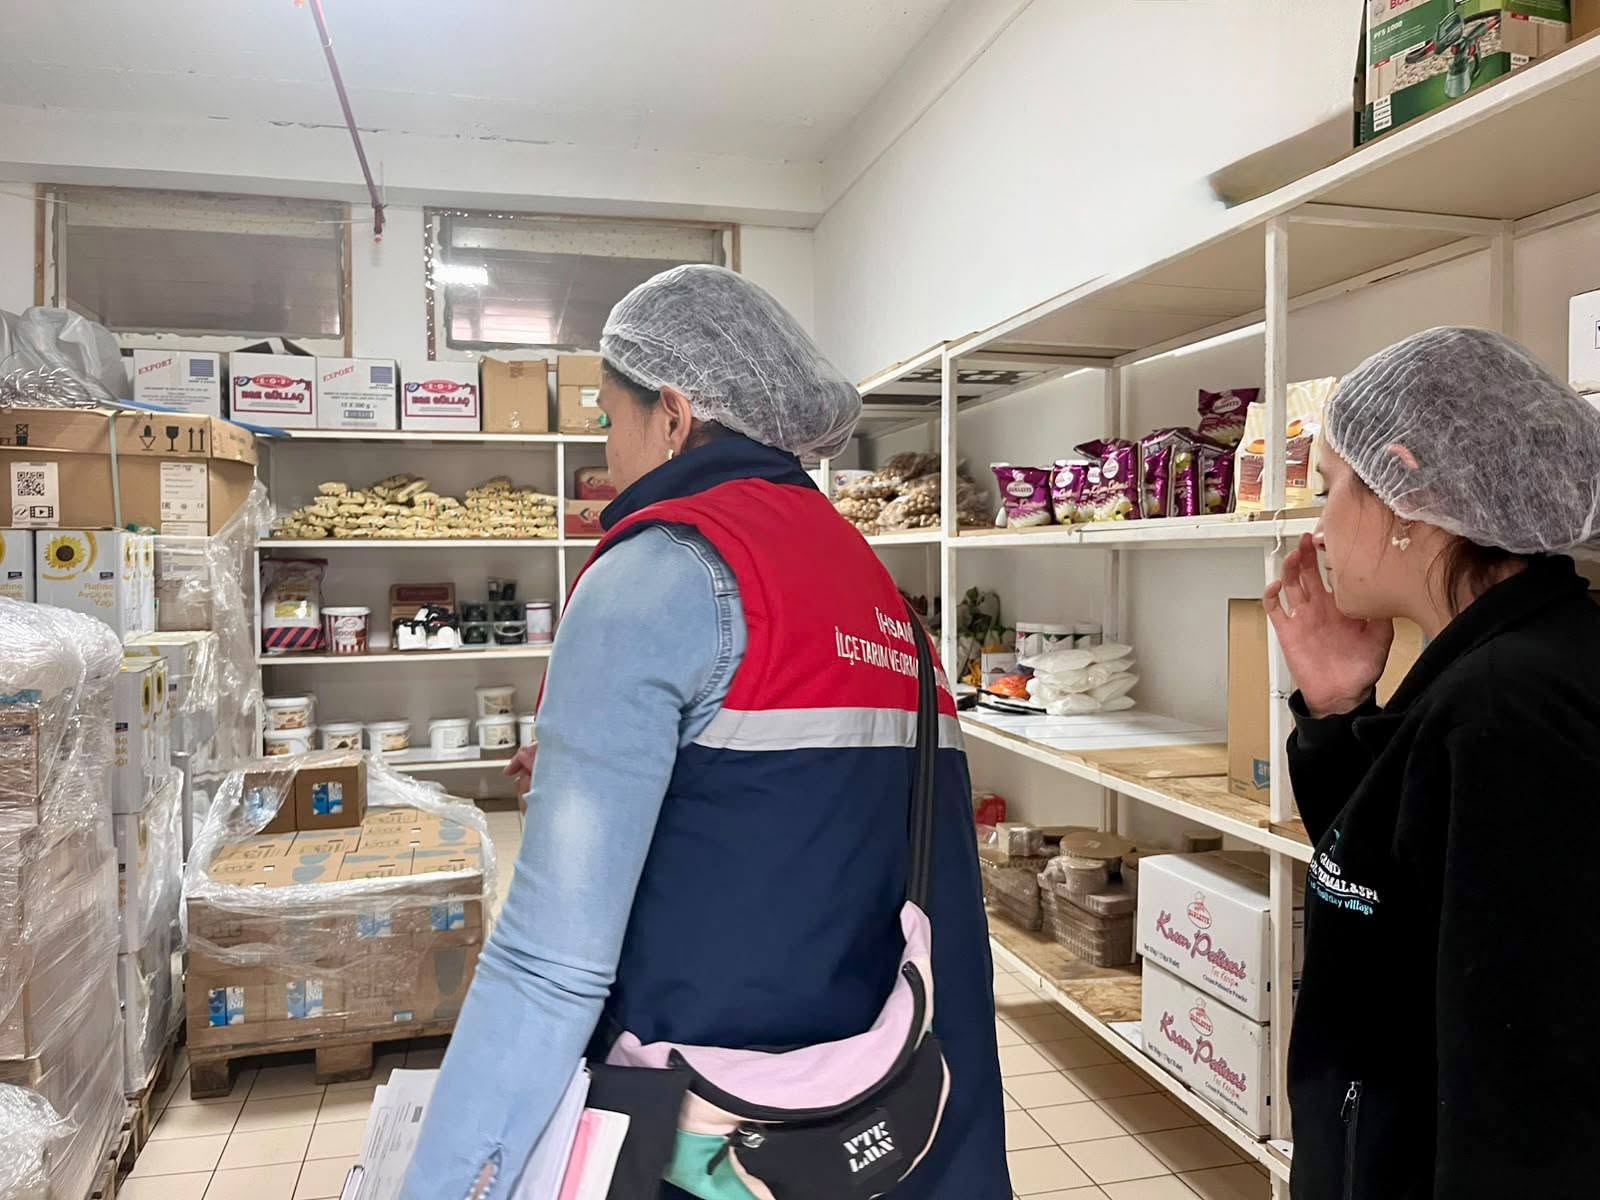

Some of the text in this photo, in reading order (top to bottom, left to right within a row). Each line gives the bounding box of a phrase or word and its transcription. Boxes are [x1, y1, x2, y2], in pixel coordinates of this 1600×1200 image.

[138, 358, 173, 375] EXPORT
[323, 365, 355, 382] EXPORT
[835, 625, 861, 665] İLÇE
[859, 639, 889, 671] TARIM
[888, 648, 902, 673] VE
[899, 652, 919, 679] ORMA
[1320, 852, 1341, 876] GRAND
